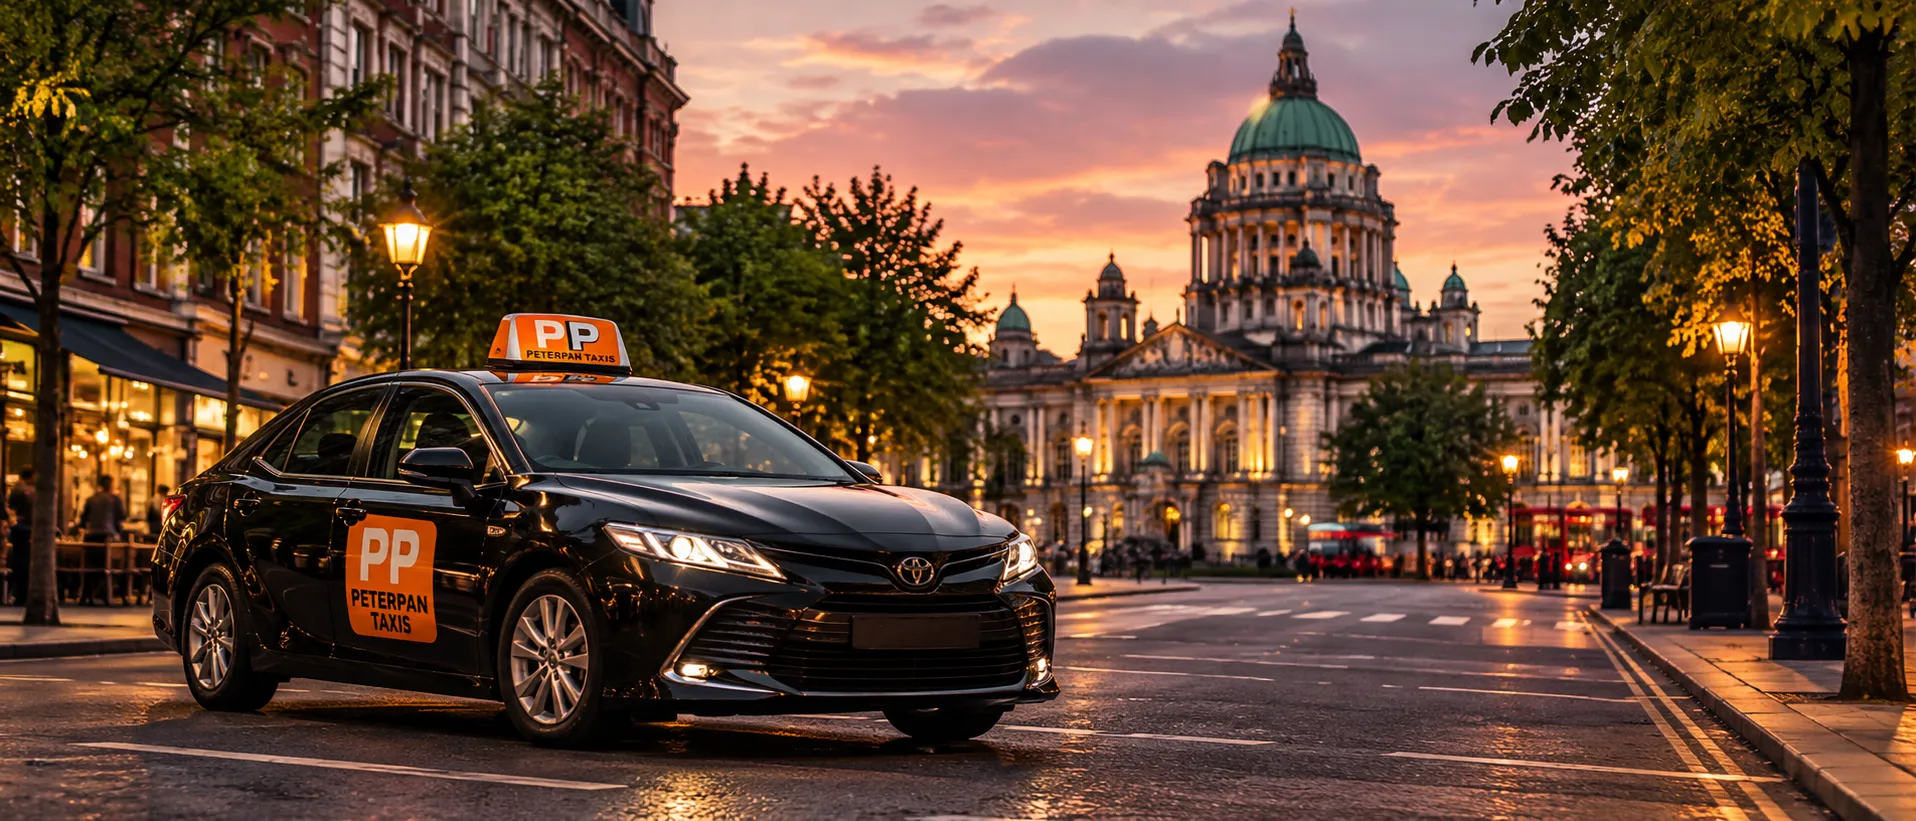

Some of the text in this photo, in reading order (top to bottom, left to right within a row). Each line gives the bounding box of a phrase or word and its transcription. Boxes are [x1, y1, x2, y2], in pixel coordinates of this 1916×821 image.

[534, 319, 599, 350] PP
[526, 350, 615, 363] PETERPAN TAXIS
[360, 527, 419, 584] PP
[351, 588, 428, 614] PETERPAN
[370, 612, 412, 634] TAXIS
